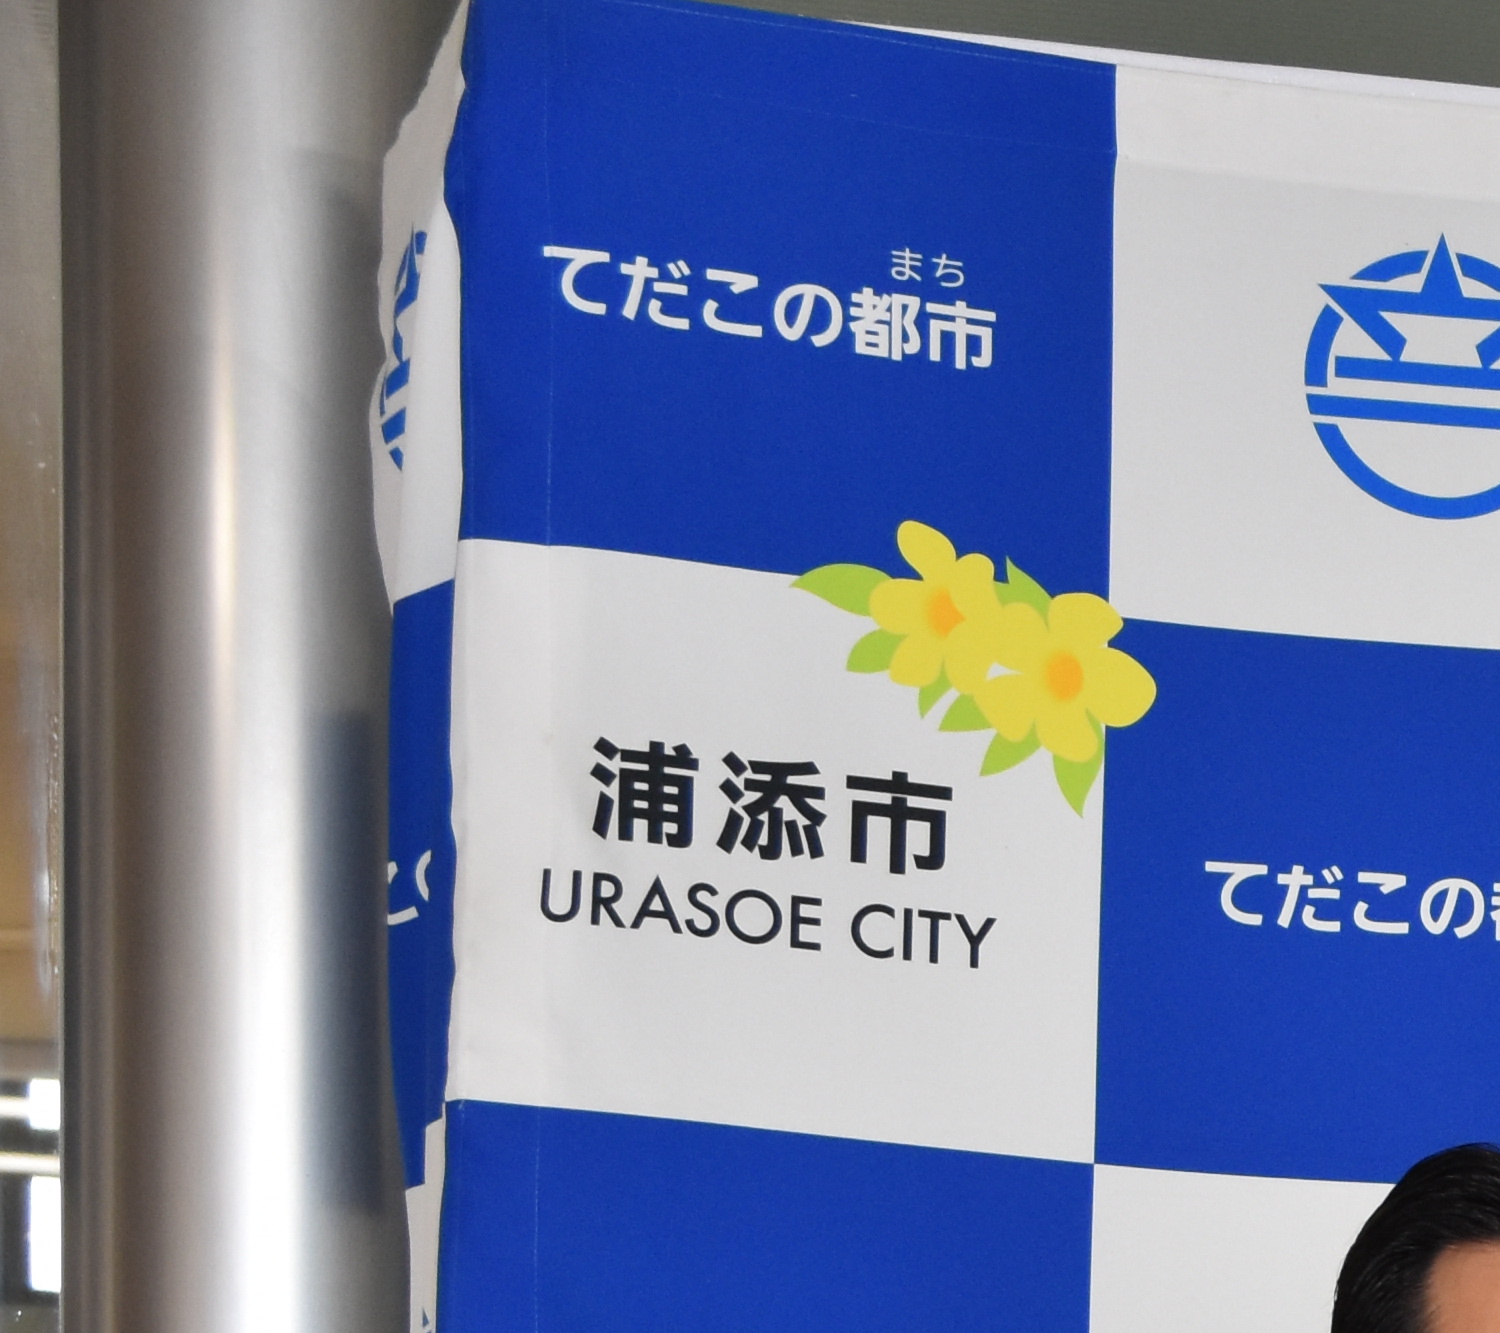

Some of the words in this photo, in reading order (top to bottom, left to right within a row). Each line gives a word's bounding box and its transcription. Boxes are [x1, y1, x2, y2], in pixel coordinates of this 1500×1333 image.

[544, 246, 996, 369] てだこの都市
[892, 248, 964, 287] まち
[590, 737, 952, 875] 浦添市
[541, 869, 822, 950] URASOE
[851, 904, 995, 968] CITY
